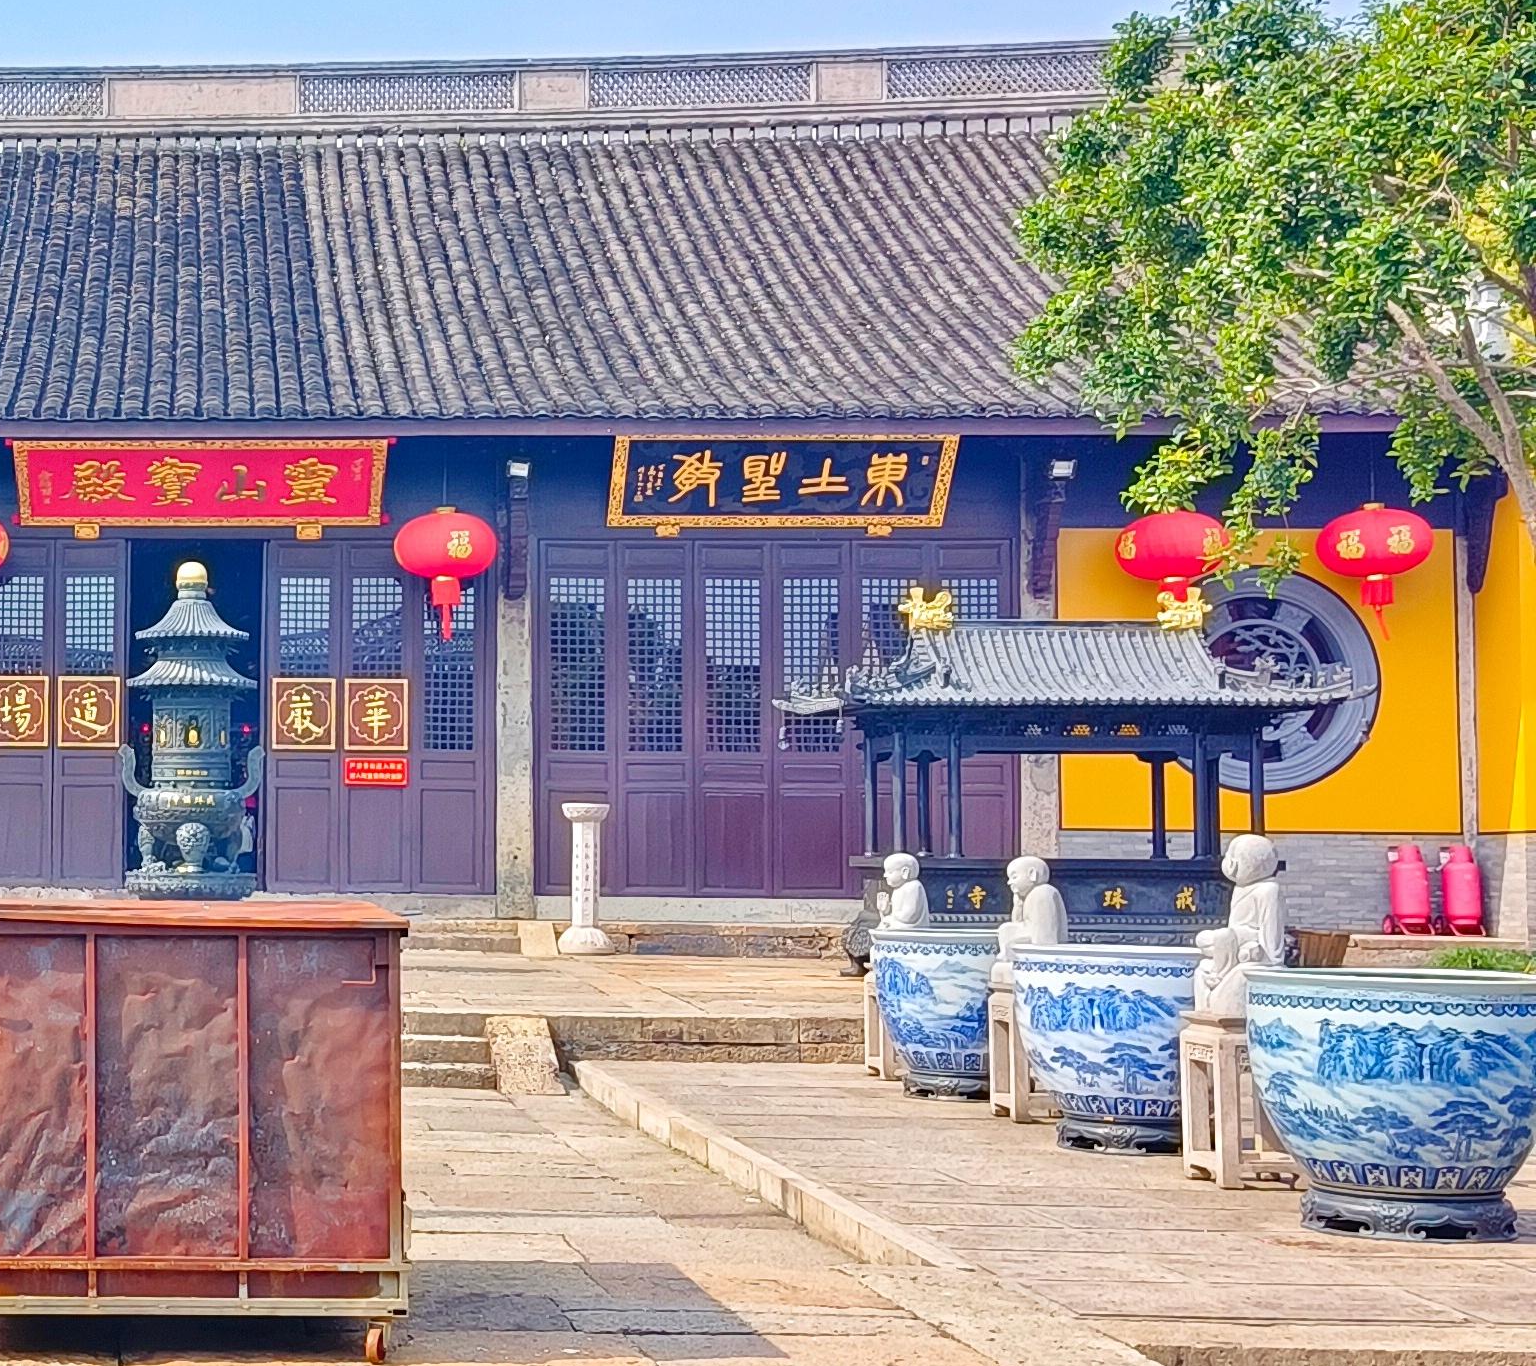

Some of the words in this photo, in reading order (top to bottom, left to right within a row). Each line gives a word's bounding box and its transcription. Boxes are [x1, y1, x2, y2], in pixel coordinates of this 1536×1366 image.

[447, 530, 473, 559] 福
[1336, 529, 1365, 559] 福
[1386, 525, 1415, 555] 福
[0, 688, 31, 733] 場
[71, 690, 108, 731] 道
[361, 691, 392, 739] 華
